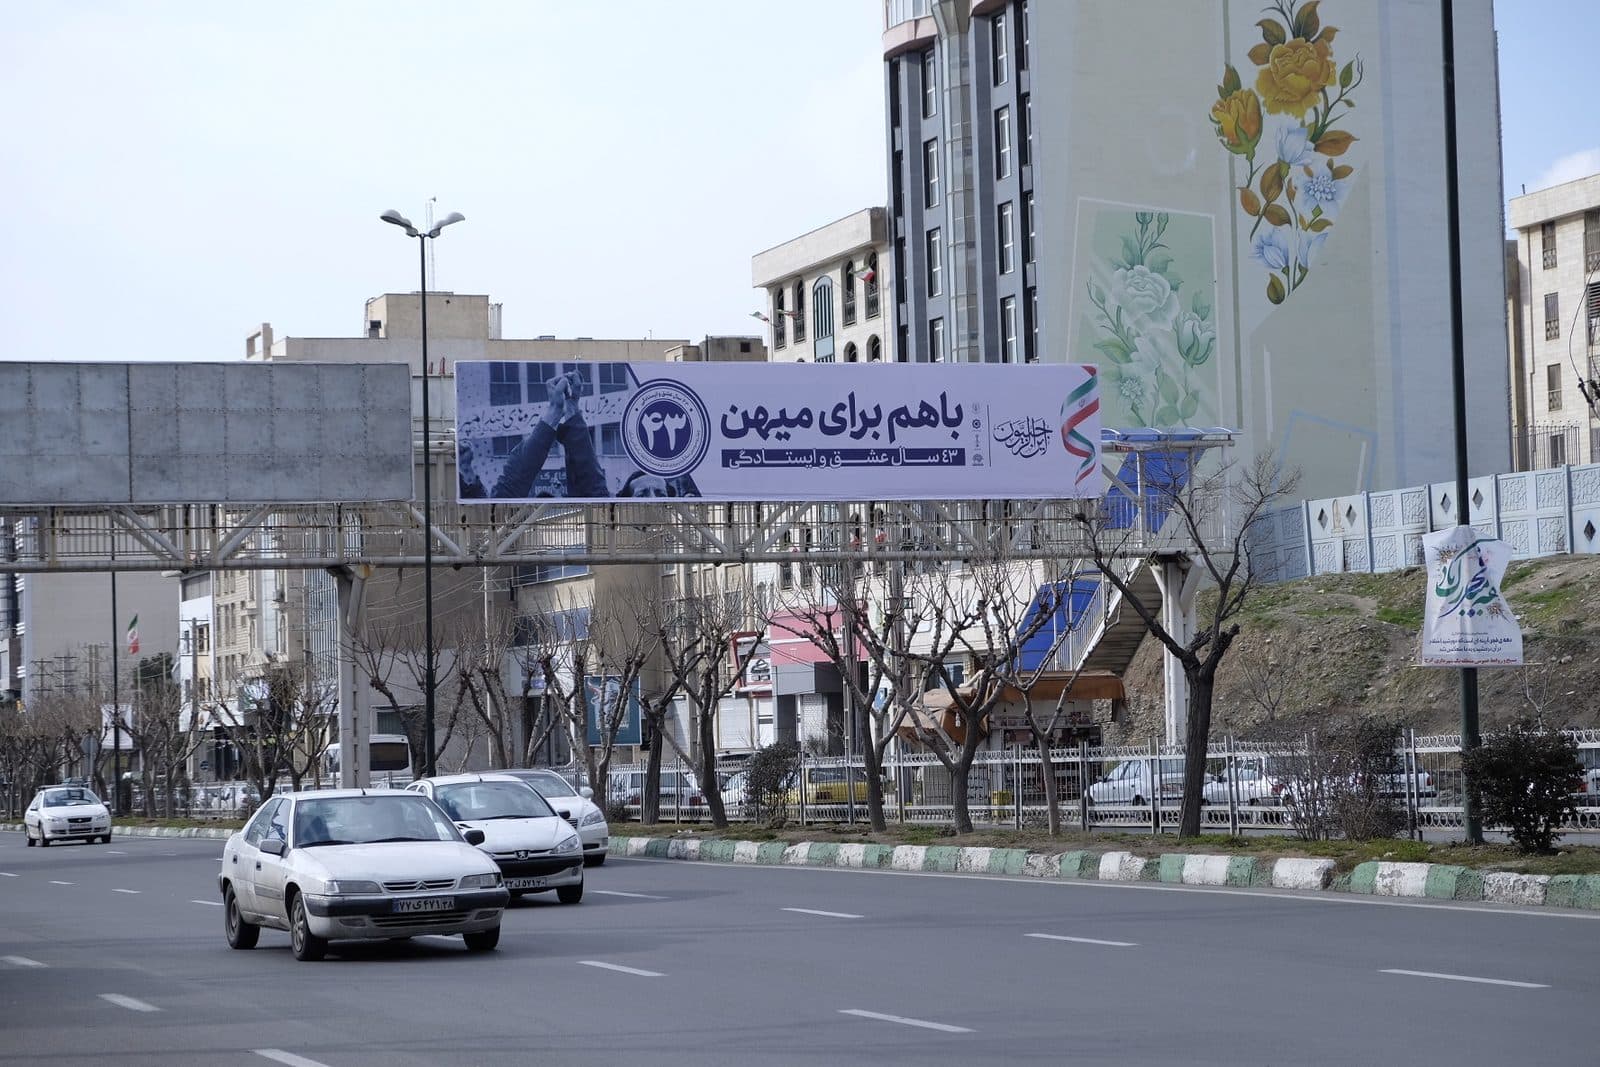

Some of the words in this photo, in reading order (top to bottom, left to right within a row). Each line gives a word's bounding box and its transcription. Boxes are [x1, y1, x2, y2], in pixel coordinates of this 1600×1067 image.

[720, 402, 814, 442] میهن
[819, 391, 883, 440] برای
[641, 411, 687, 451] ۴۳
[728, 447, 818, 470] ایستادگی
[819, 454, 827, 468] و
[829, 447, 889, 469] عشق
[891, 446, 939, 467] سال
